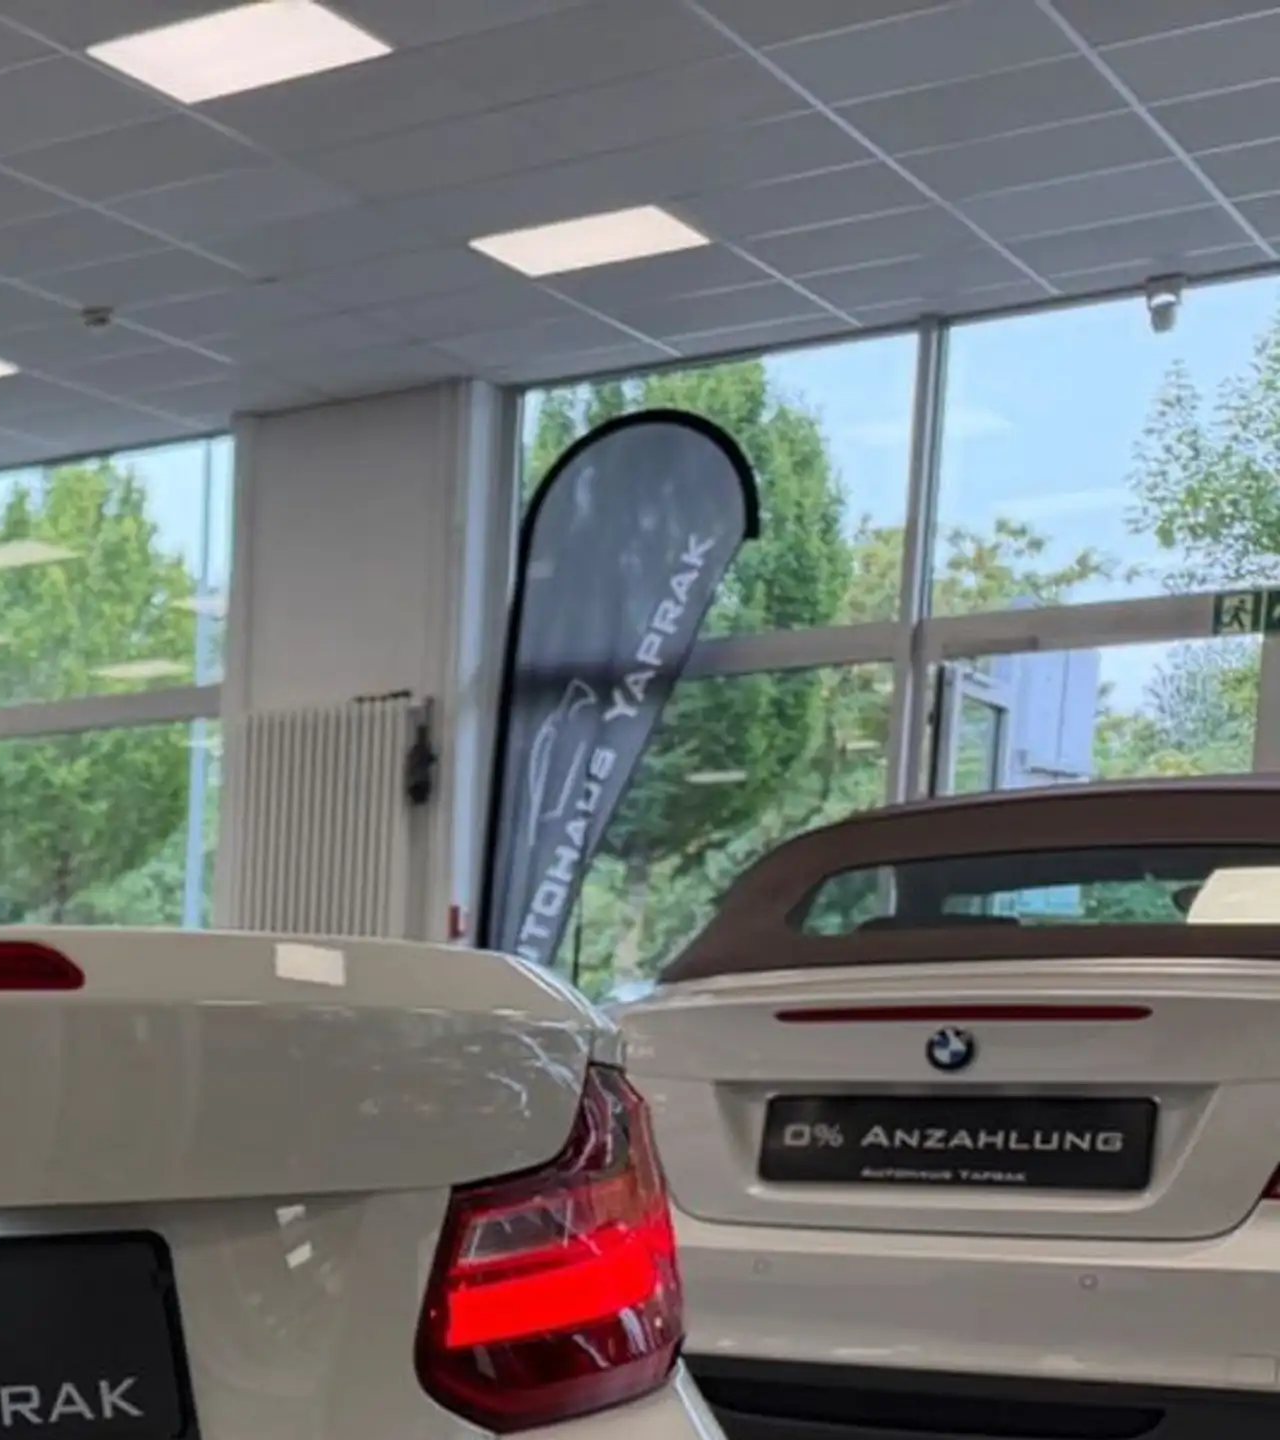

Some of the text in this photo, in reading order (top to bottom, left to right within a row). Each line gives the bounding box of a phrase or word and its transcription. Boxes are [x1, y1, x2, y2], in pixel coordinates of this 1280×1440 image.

[516, 532, 717, 961] TOHAUS YAPRAK
[783, 1123, 1124, 1153] 0% ANZAHLUNG
